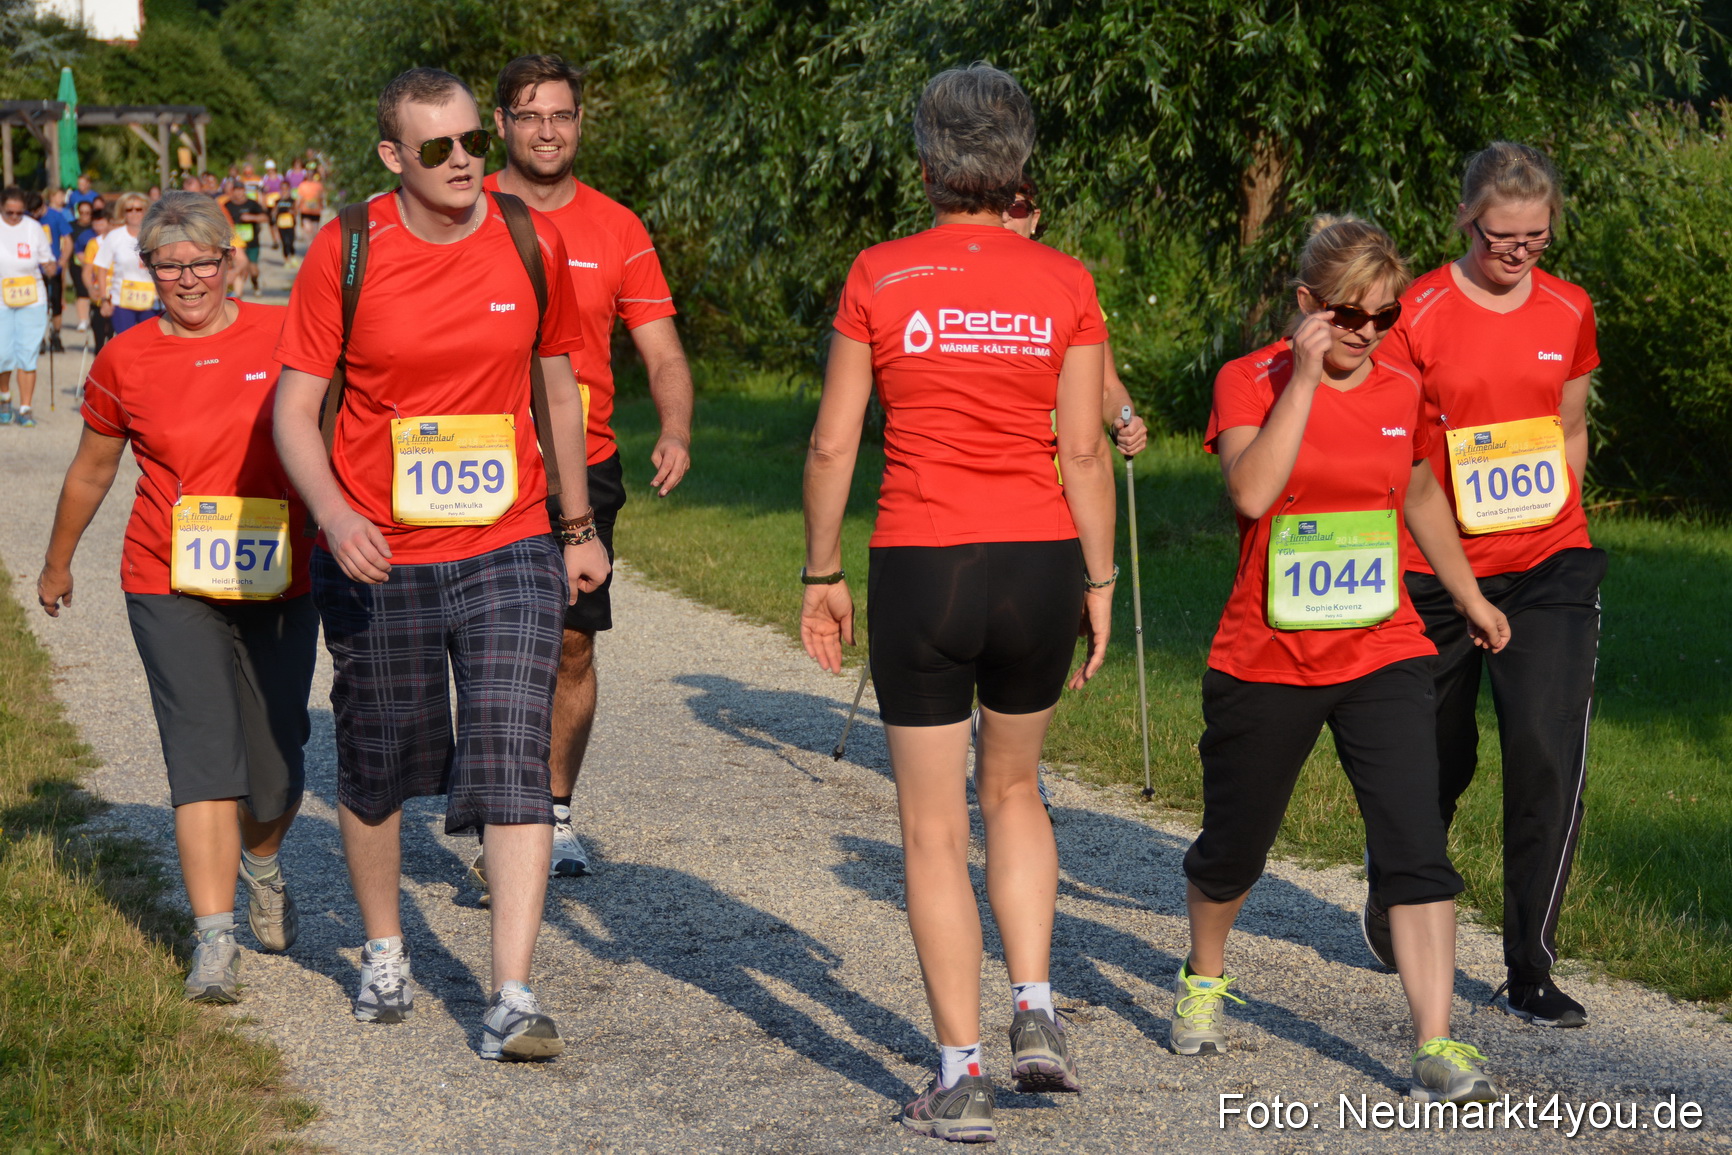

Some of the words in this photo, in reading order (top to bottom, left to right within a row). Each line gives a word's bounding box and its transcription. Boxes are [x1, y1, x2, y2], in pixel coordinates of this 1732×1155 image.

[346, 232, 359, 287] DAKINE
[9, 288, 31, 299] 214
[490, 302, 516, 313] Eugen
[938, 308, 1052, 344] Petry
[940, 343, 979, 353] WÄRME
[983, 343, 1018, 354] KÄLTE
[1022, 347, 1051, 357] KLIMA
[1538, 351, 1563, 361] Carina
[245, 371, 266, 381] Heidi
[411, 433, 455, 442] firmenlauf
[1381, 427, 1406, 437] Sophie
[399, 446, 434, 455] walken
[1467, 440, 1507, 452] firmenlauf
[407, 459, 505, 495] 1059
[1466, 460, 1555, 504] 1060
[1476, 509, 1498, 518] Carina
[1499, 502, 1552, 514] Schneiderbauer
[191, 513, 233, 521] firmenlauf
[179, 524, 213, 532] walken
[1289, 532, 1334, 542] firmenlauf
[186, 538, 279, 571] 1057
[1284, 557, 1386, 597] 1044
[1305, 604, 1333, 613] Sophie
